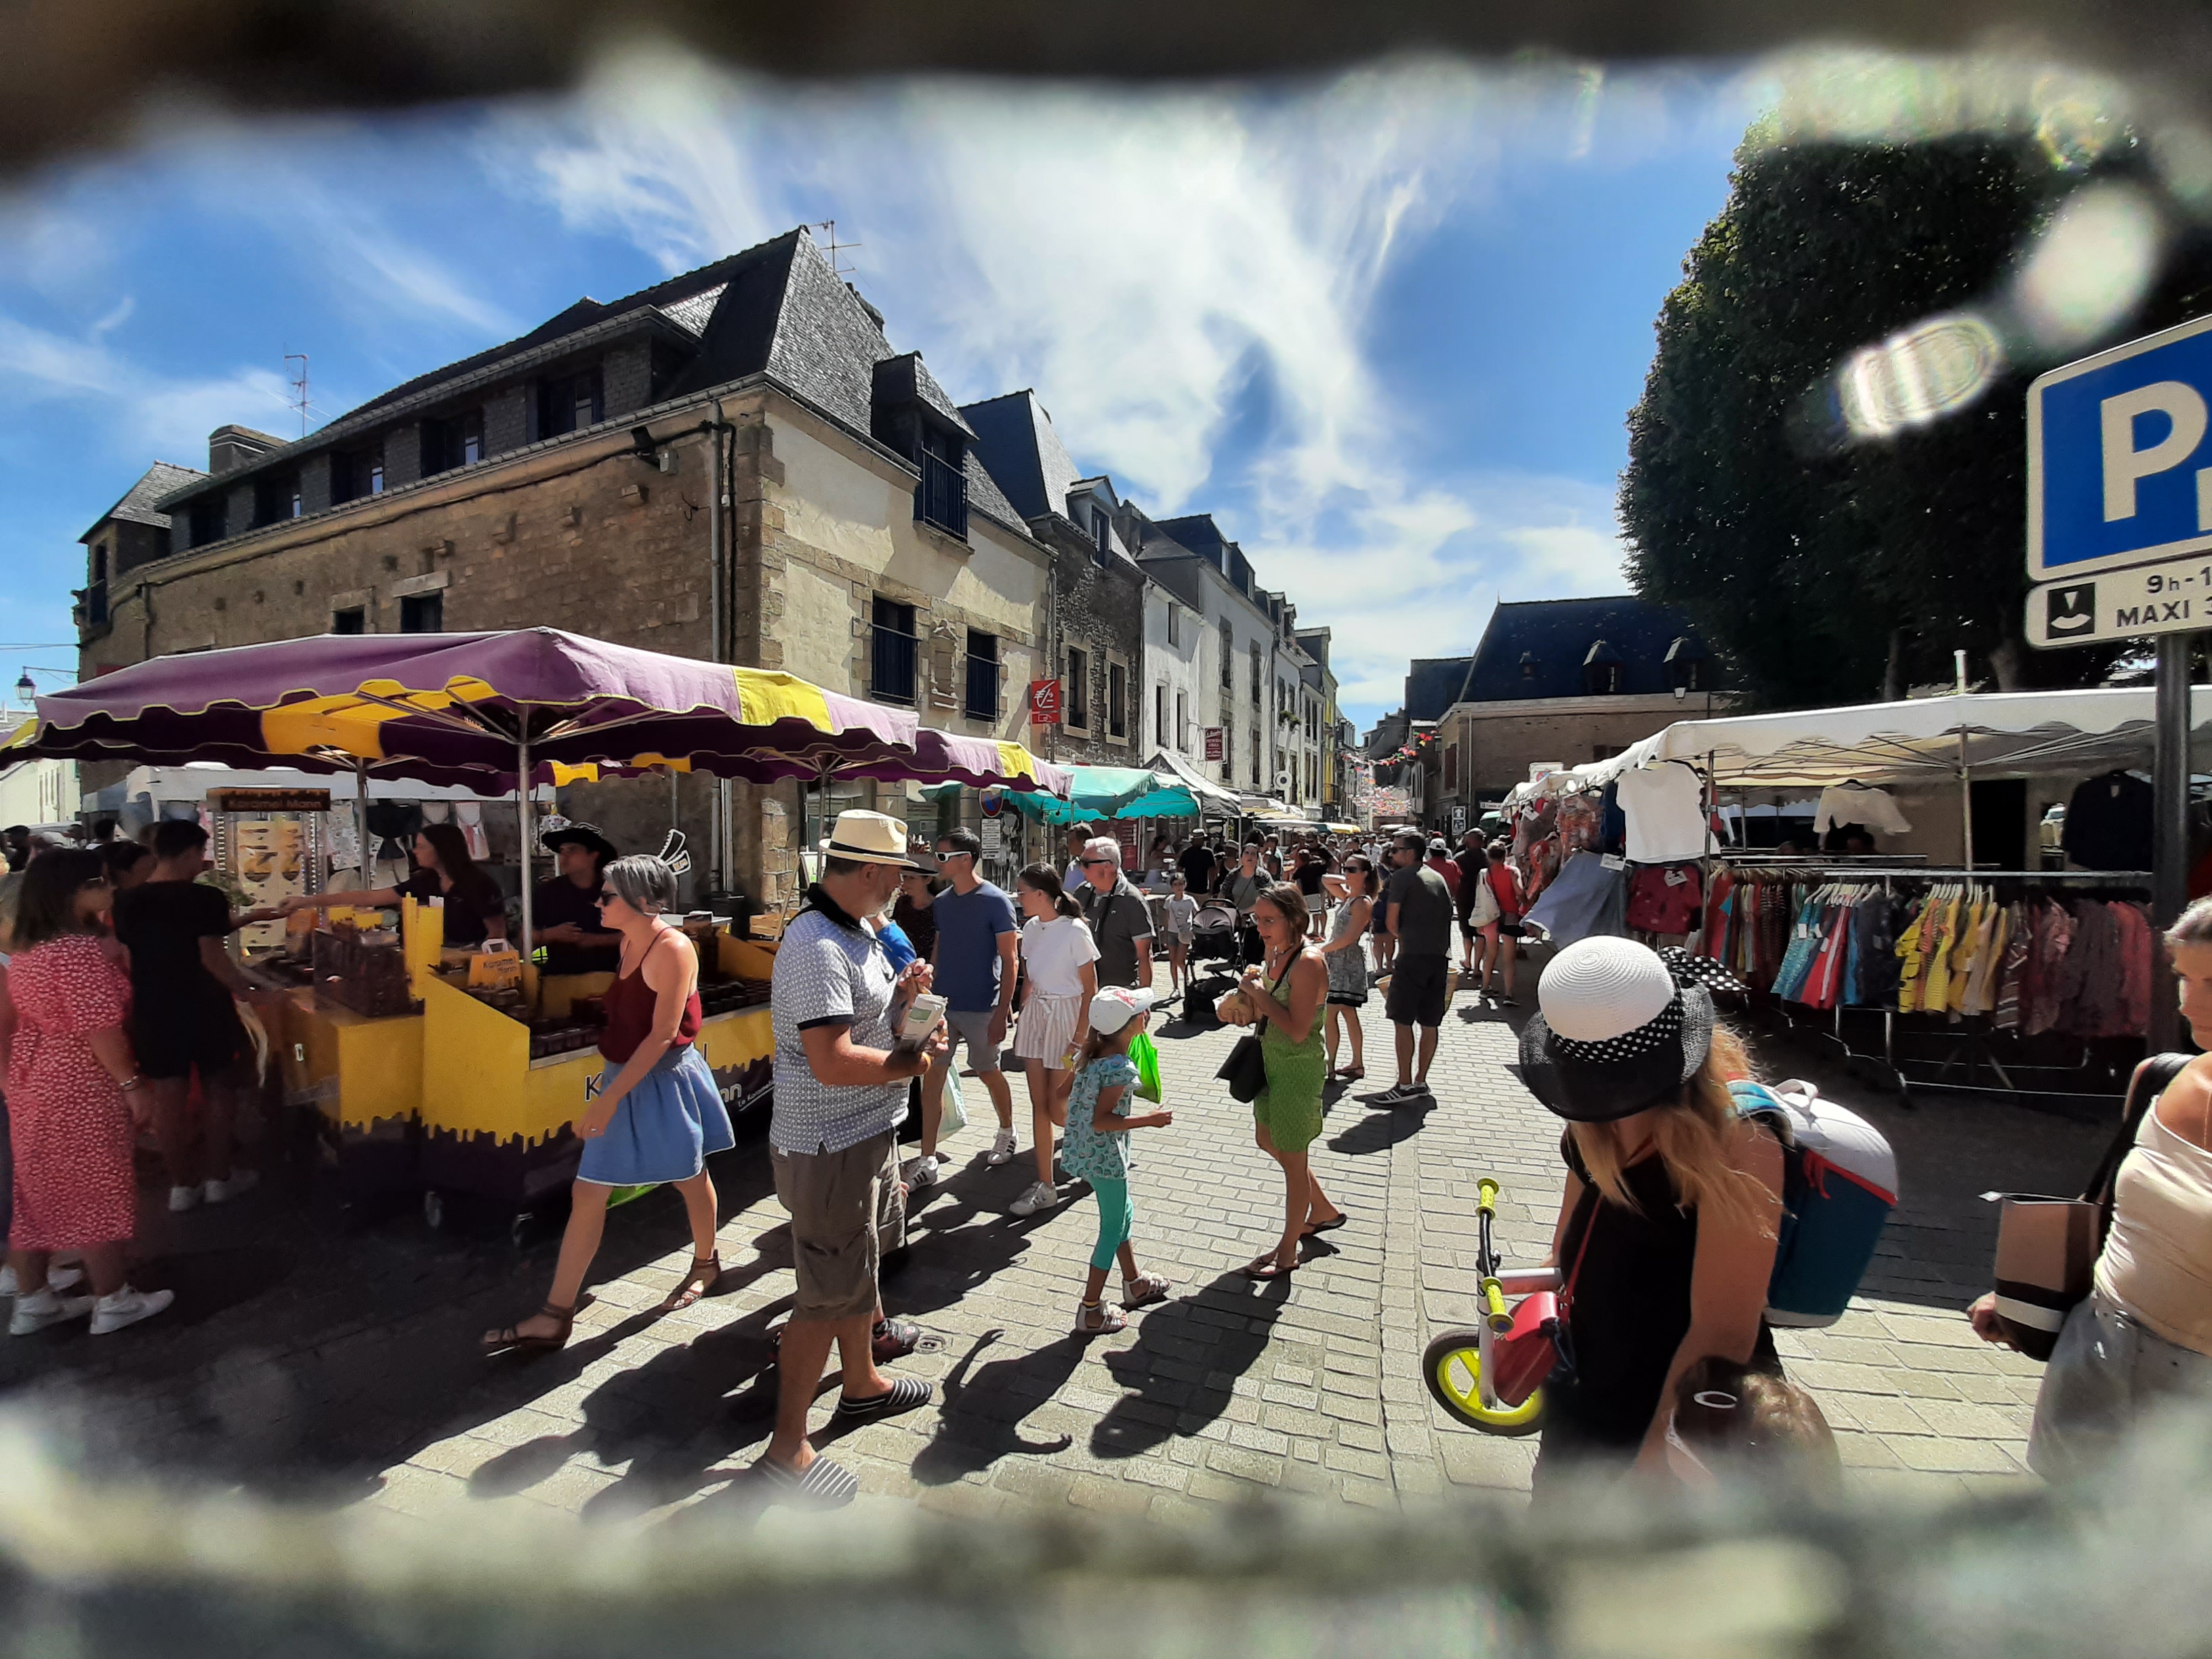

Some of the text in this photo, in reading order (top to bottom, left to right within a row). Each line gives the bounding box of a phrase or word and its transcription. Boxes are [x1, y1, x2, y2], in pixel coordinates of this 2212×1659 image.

[2101, 380, 2208, 523] P
[2116, 600, 2189, 628] MAXI
[228, 799, 283, 808] Karamel
